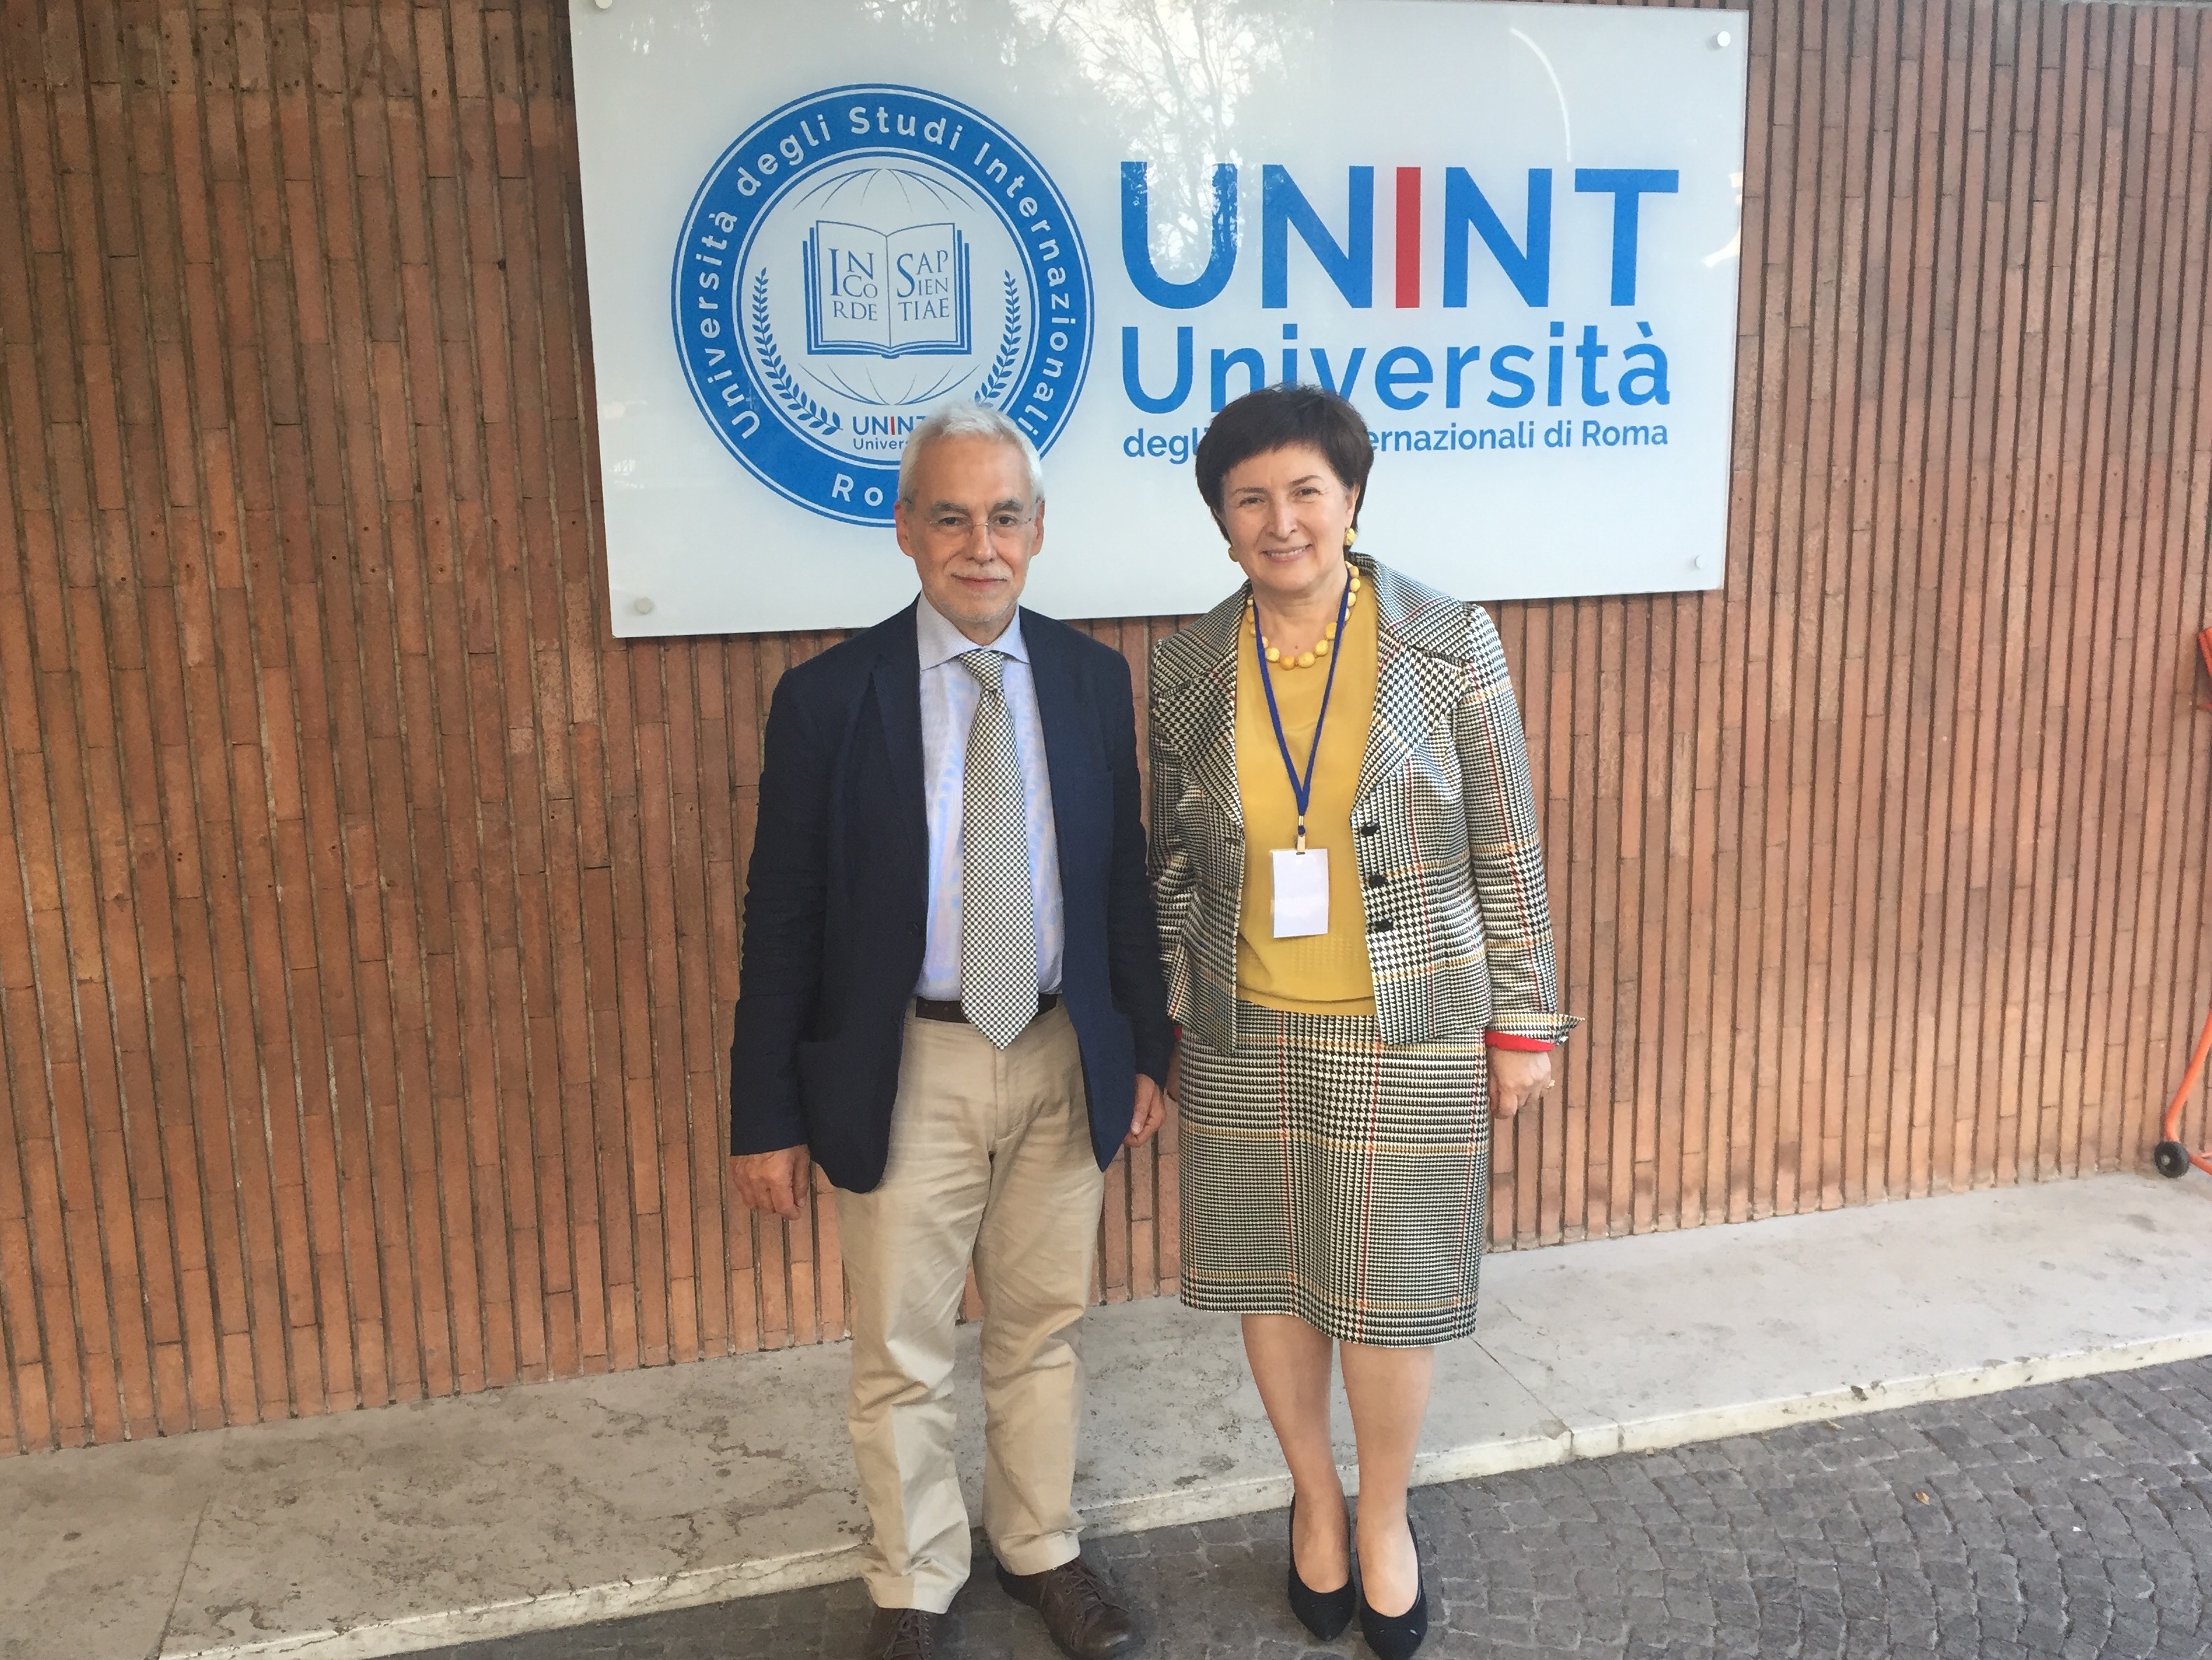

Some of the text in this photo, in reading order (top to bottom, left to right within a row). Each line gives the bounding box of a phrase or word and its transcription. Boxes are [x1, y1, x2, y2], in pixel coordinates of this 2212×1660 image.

[1120, 161, 1679, 309] UNINT
[695, 106, 1076, 439] Università degli Studi Internazionali
[833, 301, 878, 321] RDE
[898, 298, 950, 321] TIAE
[1122, 321, 1671, 414] Università
[853, 416, 926, 435] UNIN
[1122, 426, 1203, 465] degl
[1544, 420, 1571, 448] di
[1582, 420, 1668, 447] Roma
[831, 473, 884, 506] Ro
